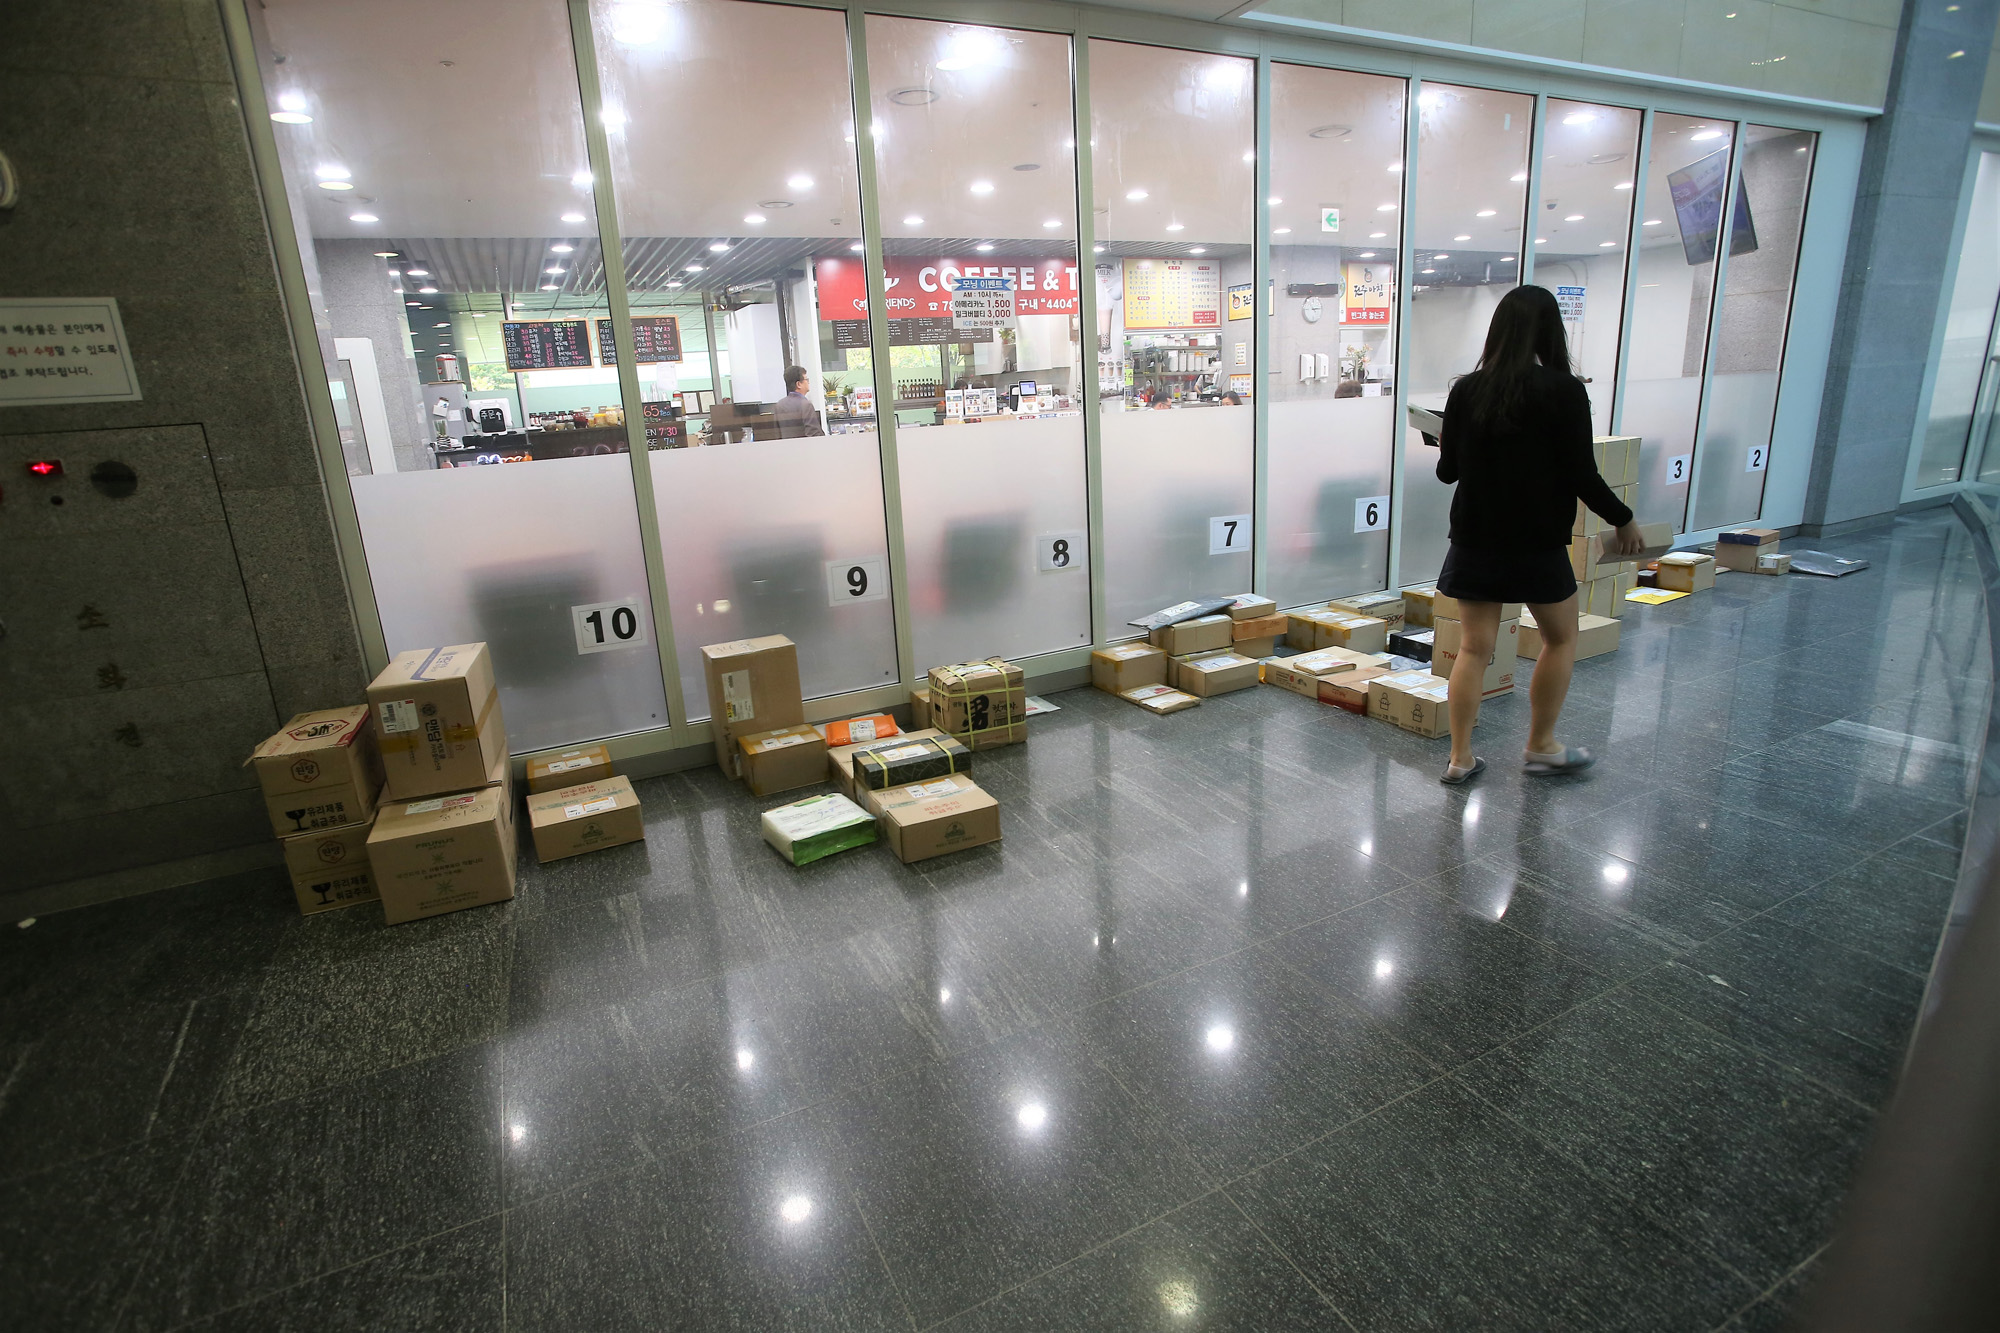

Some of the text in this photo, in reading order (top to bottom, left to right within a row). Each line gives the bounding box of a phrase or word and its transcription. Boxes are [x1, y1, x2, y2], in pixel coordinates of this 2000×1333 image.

[963, 279, 1003, 288] 모닝 이벤트
[1042, 270, 1059, 290] &
[853, 298, 916, 311] Caf RIENDS
[955, 300, 1010, 309] 아메리카노 1,500
[1018, 299, 1038, 310] 구내
[987, 309, 1011, 319] 3,000
[1351, 311, 1385, 320] 빈그릇 놓는곳
[63, 323, 106, 334] 본인에게
[7, 344, 118, 357] 즉시 수령할 수 있도록
[25, 366, 93, 379] 부탁드립니다.
[481, 410, 495, 419] 주문
[643, 405, 660, 417] 65
[645, 427, 678, 437] EN 7:30
[1752, 449, 1761, 468] 2
[1673, 459, 1683, 479] 3
[1366, 502, 1378, 526] 6
[1224, 520, 1238, 547] 7
[1053, 539, 1070, 567] 8
[847, 566, 868, 597] 9
[586, 607, 637, 643] 10
[307, 802, 345, 817] 유리제품
[310, 814, 347, 828] 취급주의
[333, 875, 369, 889] 유리제품
[336, 886, 371, 901] 취급주의
